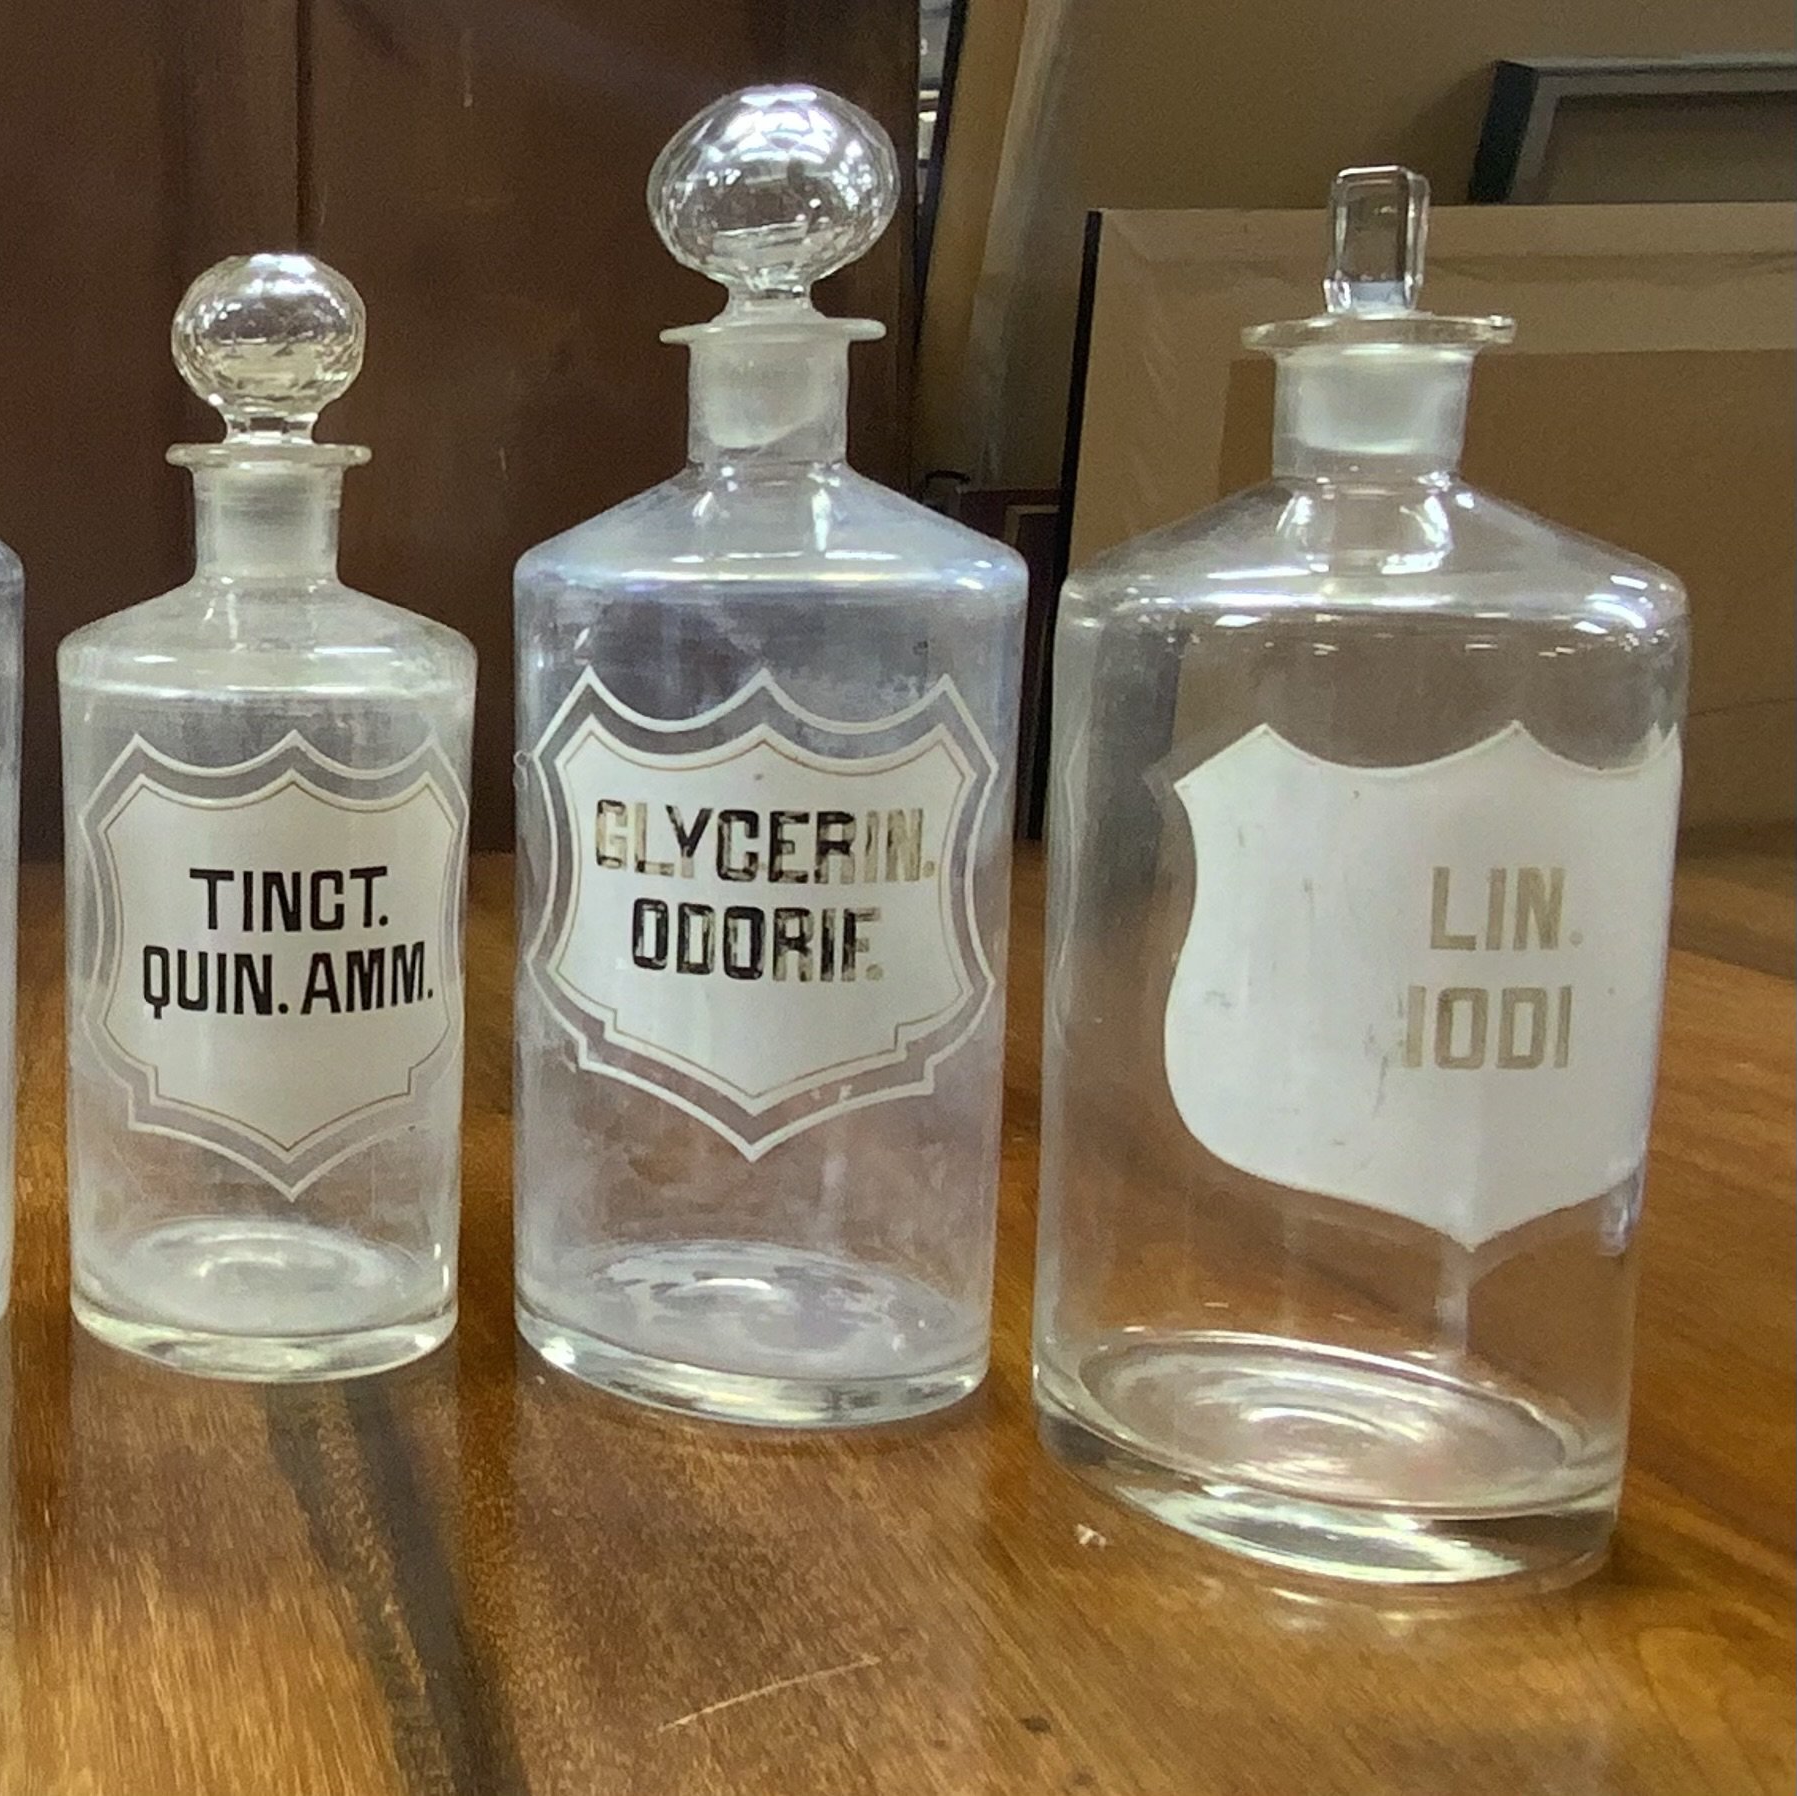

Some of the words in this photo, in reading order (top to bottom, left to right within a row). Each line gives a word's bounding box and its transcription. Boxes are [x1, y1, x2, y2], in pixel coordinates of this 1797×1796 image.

[594, 798, 937, 885] GLYCERIN.
[188, 865, 389, 933] TINCT.
[631, 897, 885, 983] ODORIF.
[1429, 866, 1585, 952] LIN.
[142, 944, 290, 1020] QUIN.
[299, 941, 434, 1015] AMM.
[1404, 984, 1573, 1070] IODI
